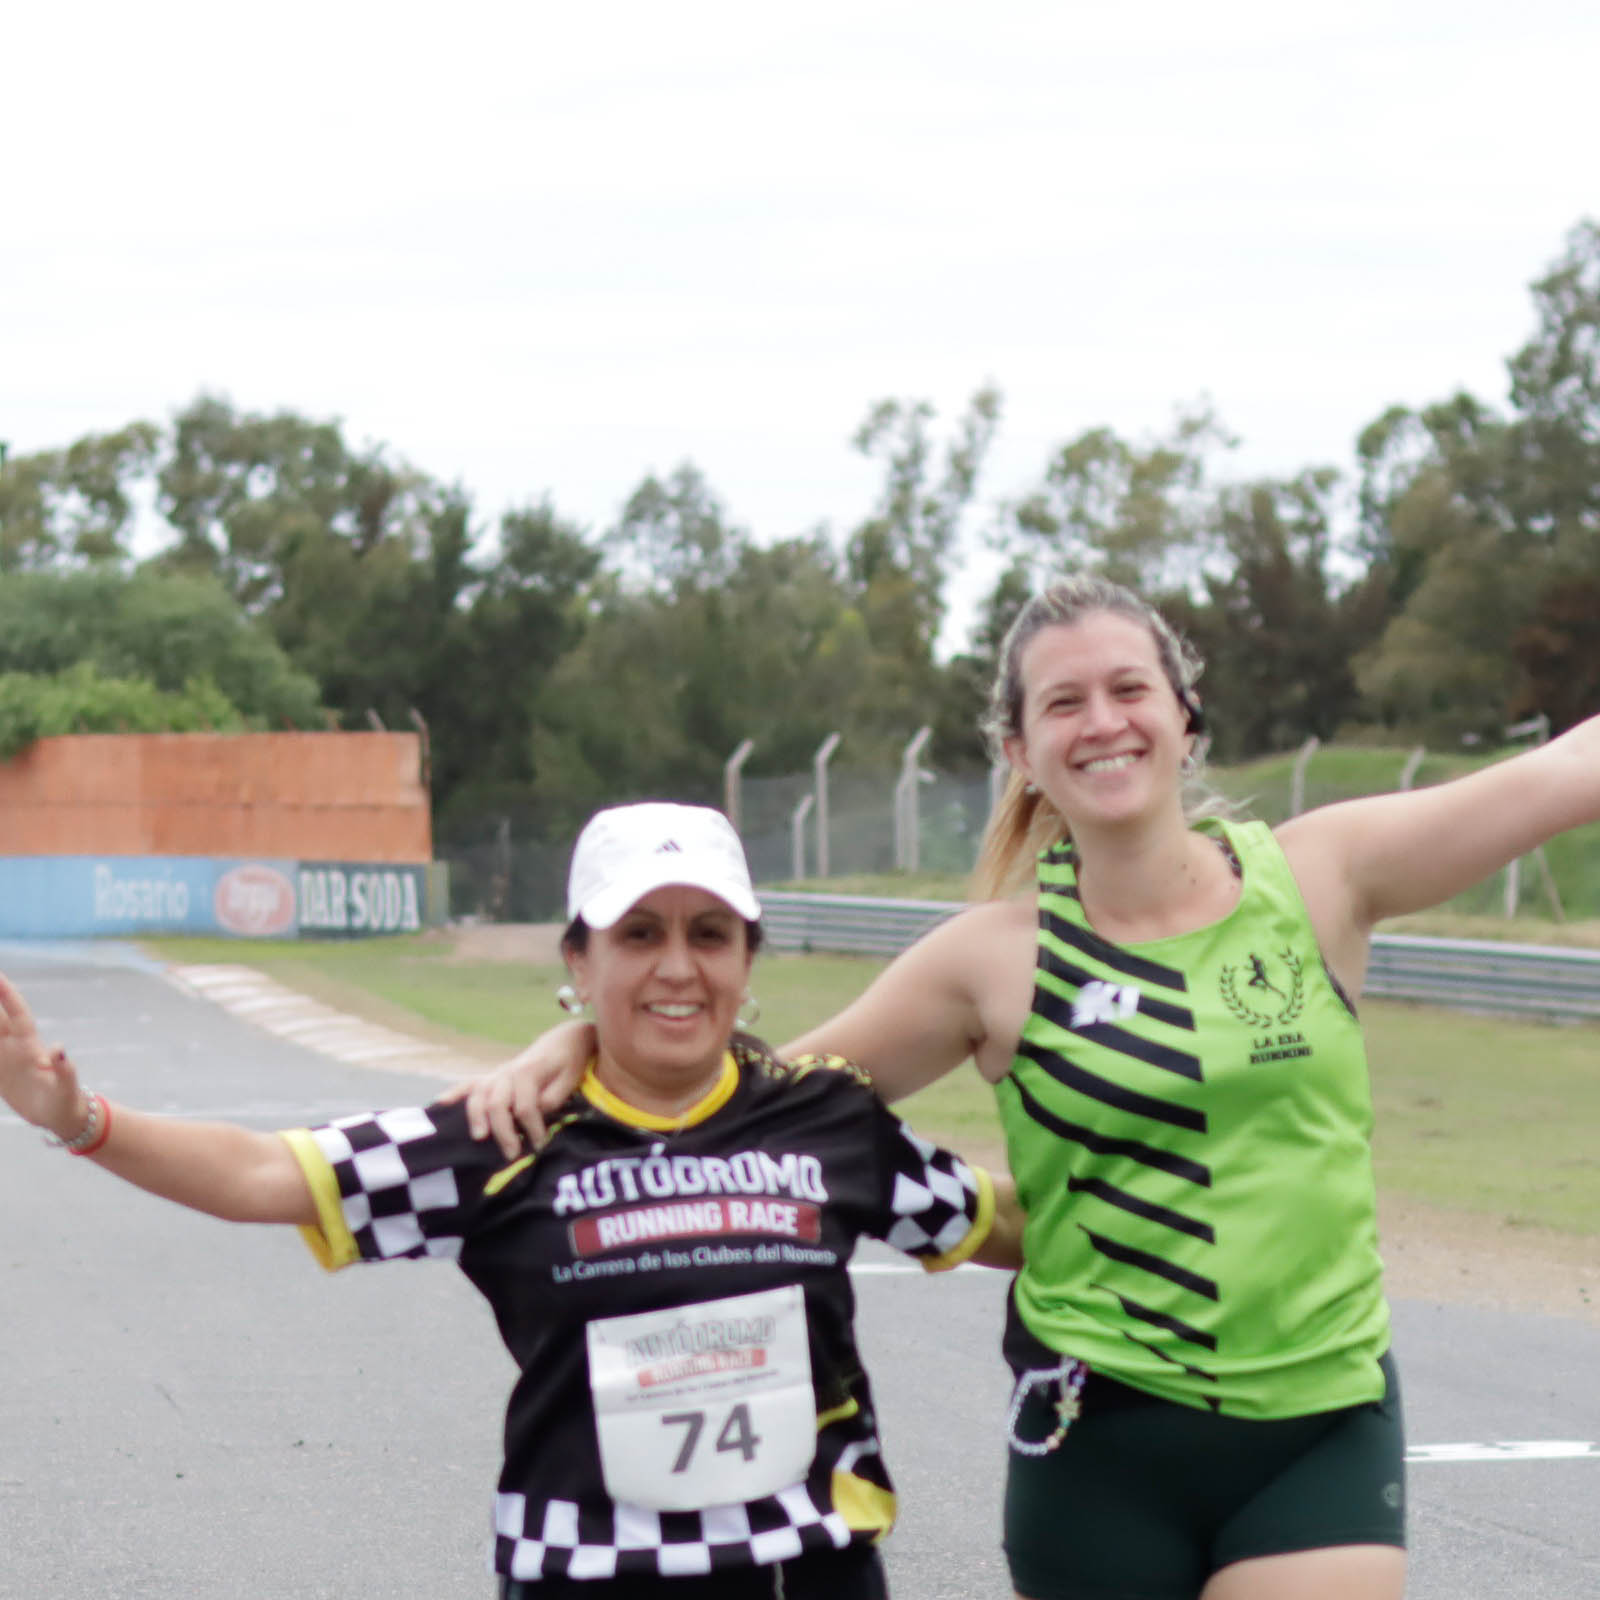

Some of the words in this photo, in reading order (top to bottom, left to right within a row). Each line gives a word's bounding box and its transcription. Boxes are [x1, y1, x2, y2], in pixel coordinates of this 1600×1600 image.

[92, 864, 189, 920] Rosario
[552, 1142, 829, 1216] AUTÓDROMO
[597, 1202, 723, 1249] RUNNING
[728, 1200, 799, 1236] RACE
[553, 1265, 573, 1284] La
[573, 1258, 636, 1280] Carrera
[637, 1252, 662, 1272] de
[664, 1249, 691, 1268] los
[693, 1246, 752, 1266] Clubes
[753, 1243, 781, 1263] del
[660, 1402, 763, 1474] 74
